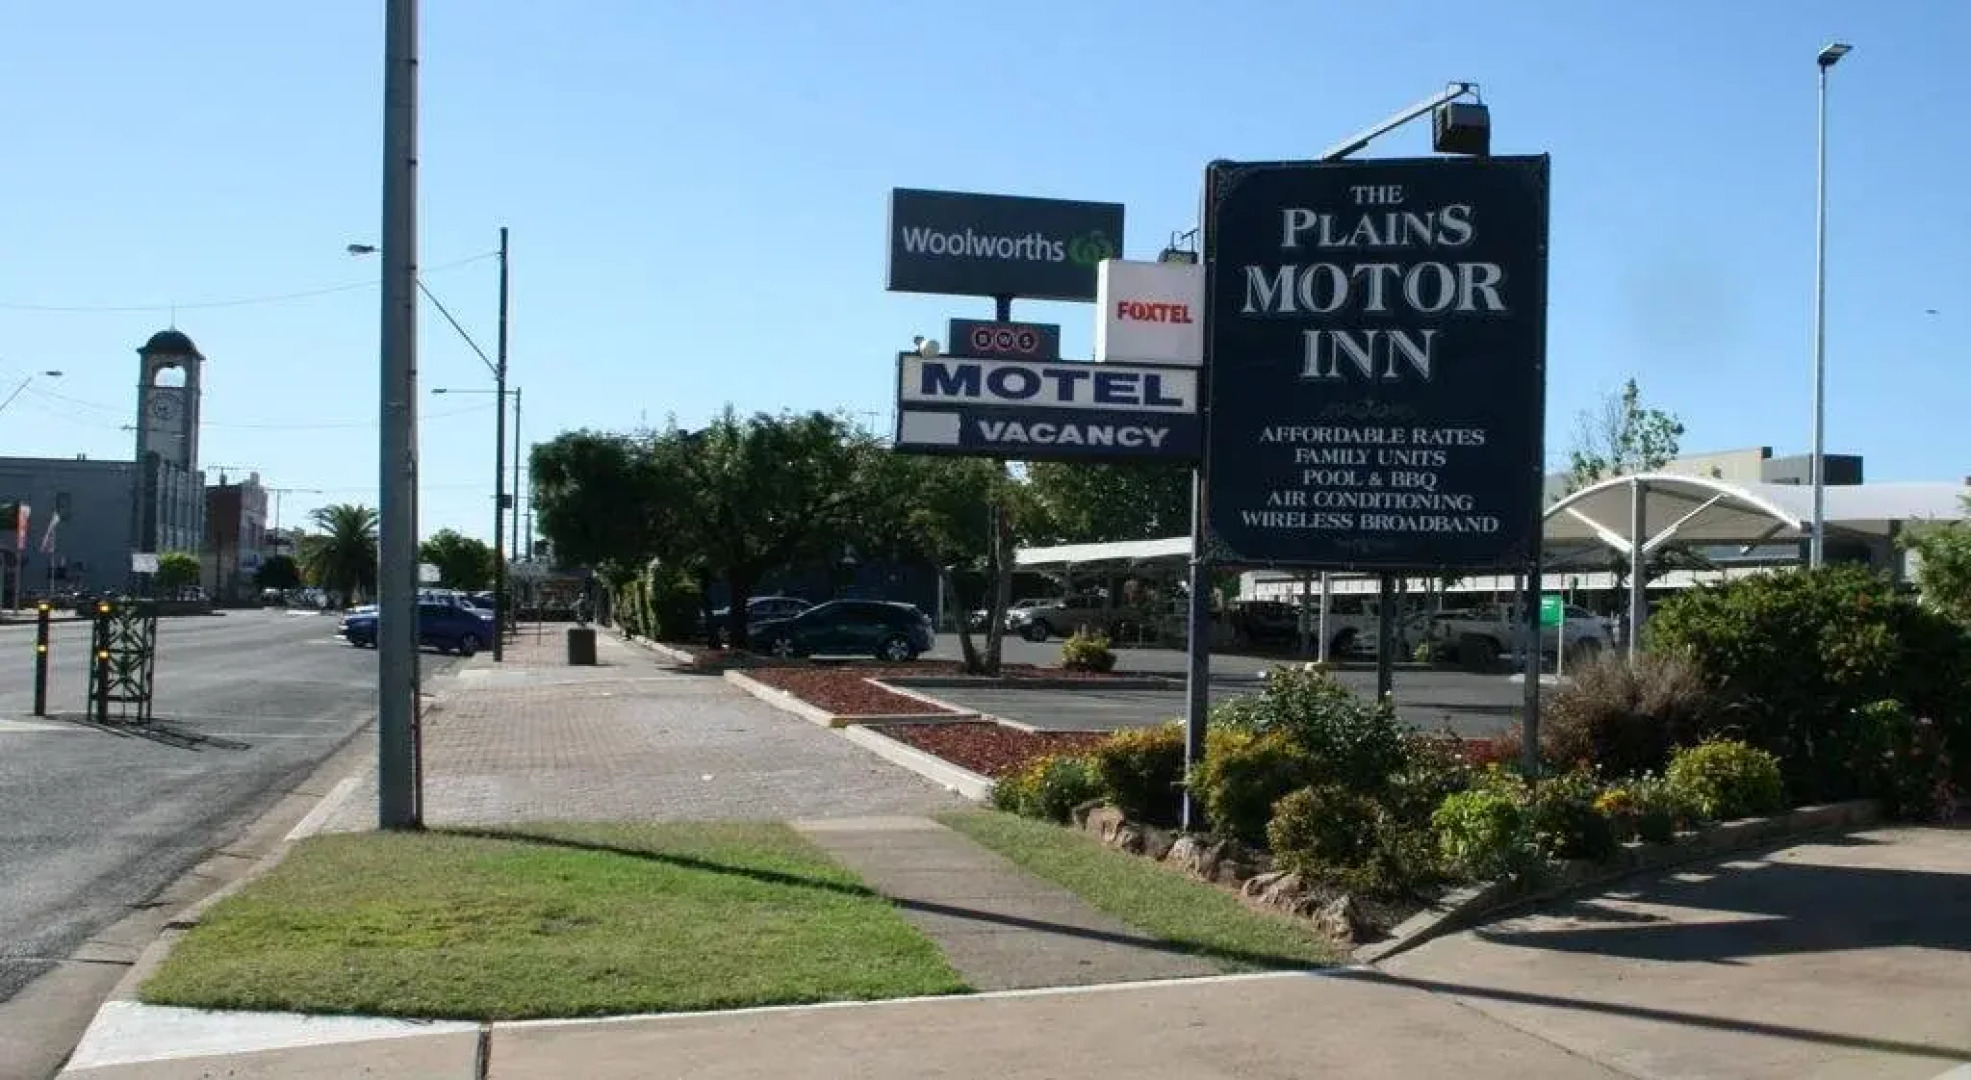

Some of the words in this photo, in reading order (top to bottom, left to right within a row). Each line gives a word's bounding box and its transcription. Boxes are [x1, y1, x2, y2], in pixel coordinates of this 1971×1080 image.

[1350, 185, 1403, 205] THE
[1281, 203, 1474, 248] PLAINS
[903, 226, 1065, 262] Woolworths
[1242, 261, 1507, 313] MOTOR
[1117, 301, 1193, 323] FOXTEL
[1300, 329, 1439, 379] INN
[921, 362, 1183, 407] MOTEL
[978, 420, 1170, 448] VACANCY
[1260, 427, 1406, 444] AFFORDABLE
[1412, 429, 1486, 446] RATES
[1294, 448, 1371, 465] FAMILY
[1377, 449, 1447, 467] UNITS
[1303, 469, 1363, 486] POOL
[1368, 471, 1382, 486] &
[1391, 470, 1437, 491] BBQ
[1267, 491, 1307, 508] AIR
[1313, 492, 1474, 511] CONDITIONING
[1241, 510, 1354, 529] WIRELESS
[1360, 513, 1500, 533] BROADBAND
